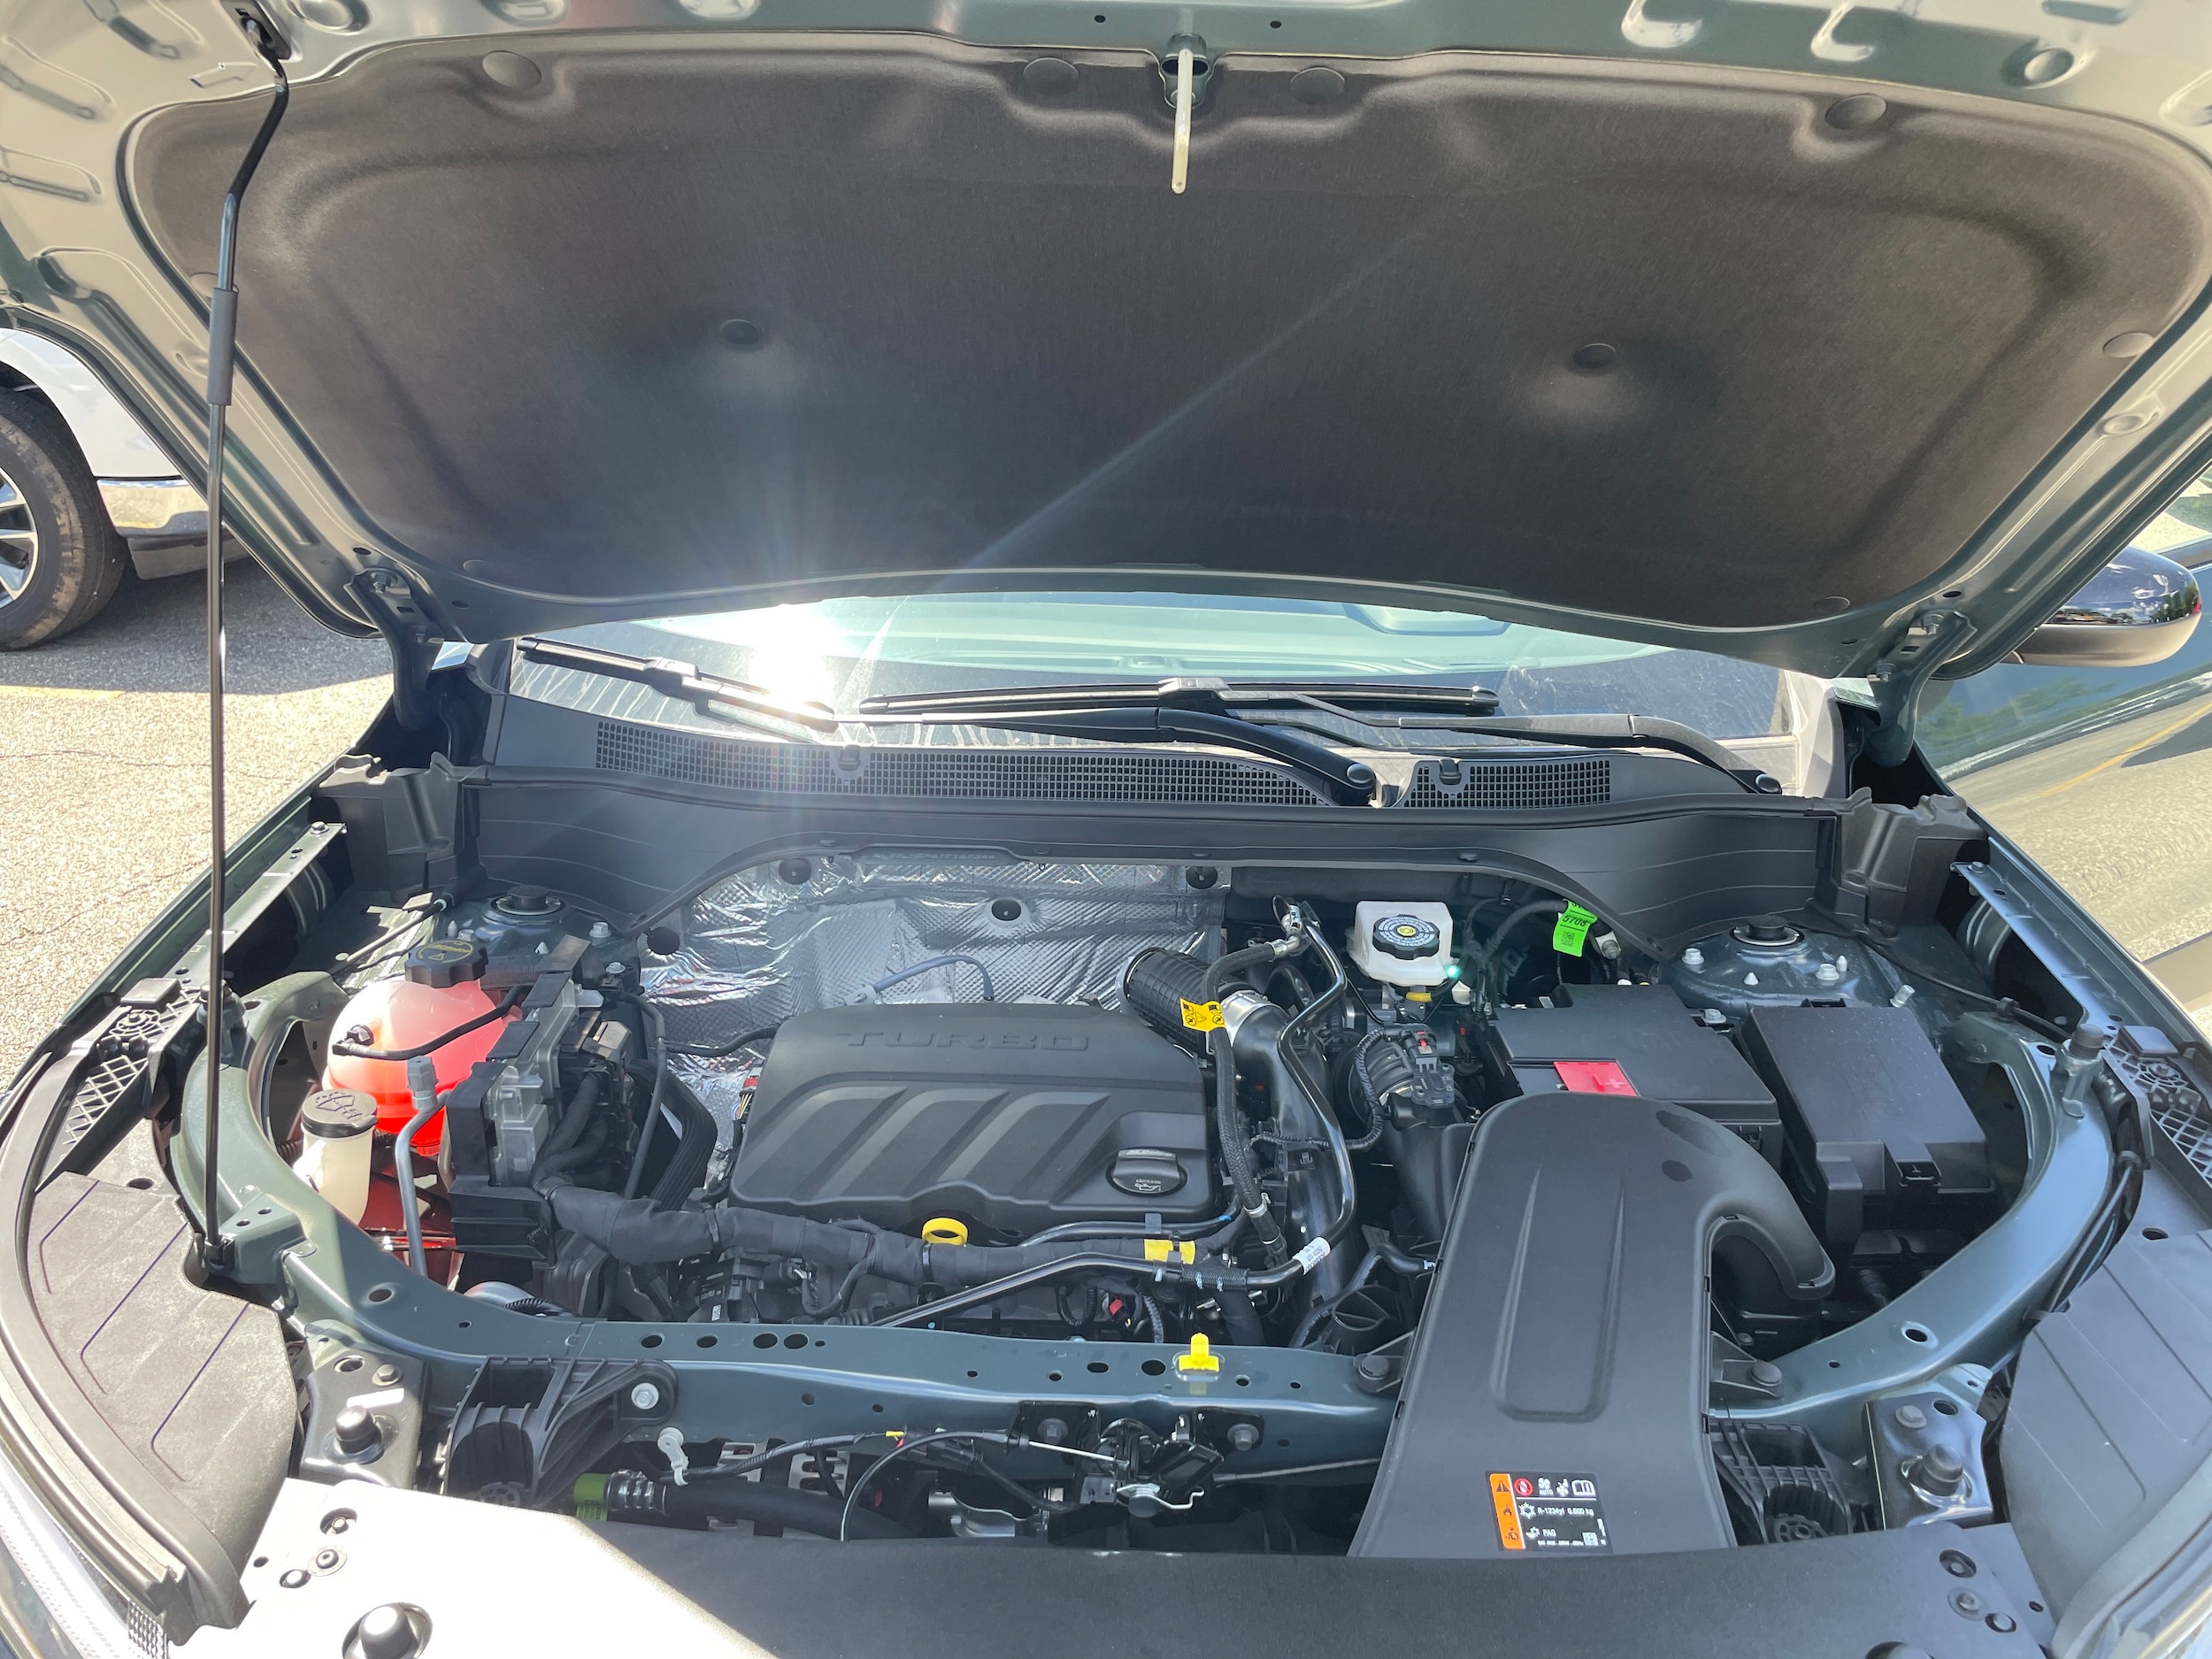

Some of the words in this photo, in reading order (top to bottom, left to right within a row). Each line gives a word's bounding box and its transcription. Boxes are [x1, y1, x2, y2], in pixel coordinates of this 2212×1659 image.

[836, 1032, 1089, 1051] TURBO
[1585, 1508, 1594, 1517] kg
[1542, 1529, 1556, 1538] PAG
